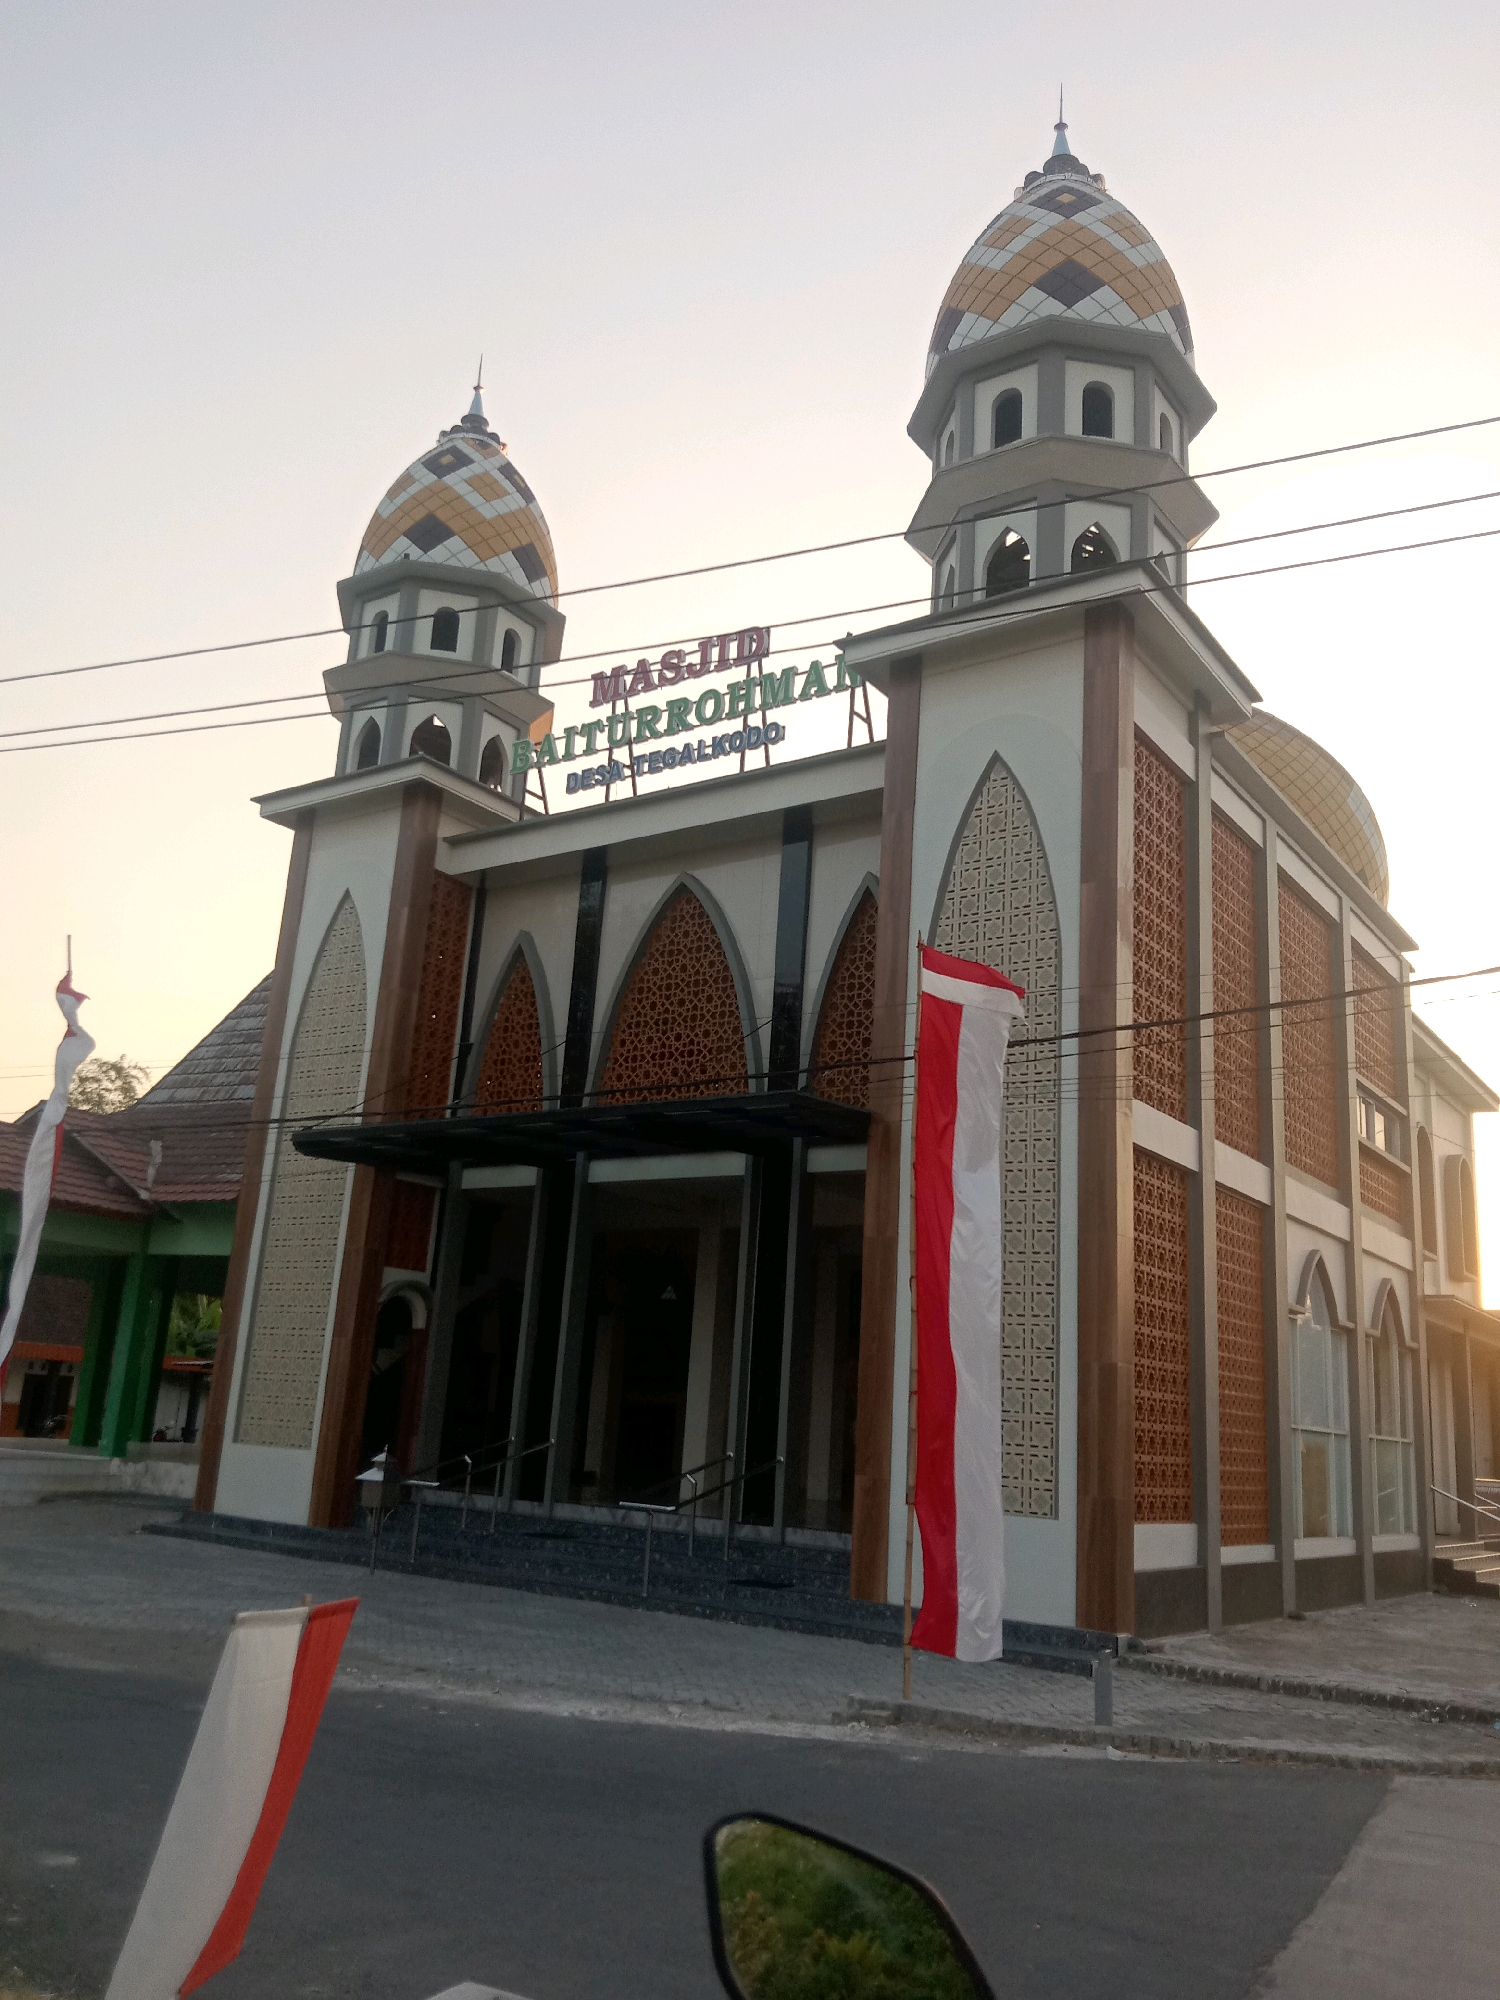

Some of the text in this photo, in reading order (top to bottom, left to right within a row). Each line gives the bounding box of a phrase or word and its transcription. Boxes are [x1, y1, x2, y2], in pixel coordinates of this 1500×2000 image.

[589, 626, 770, 708] MASJID
[566, 721, 785, 794] DESA TEGALKODO
